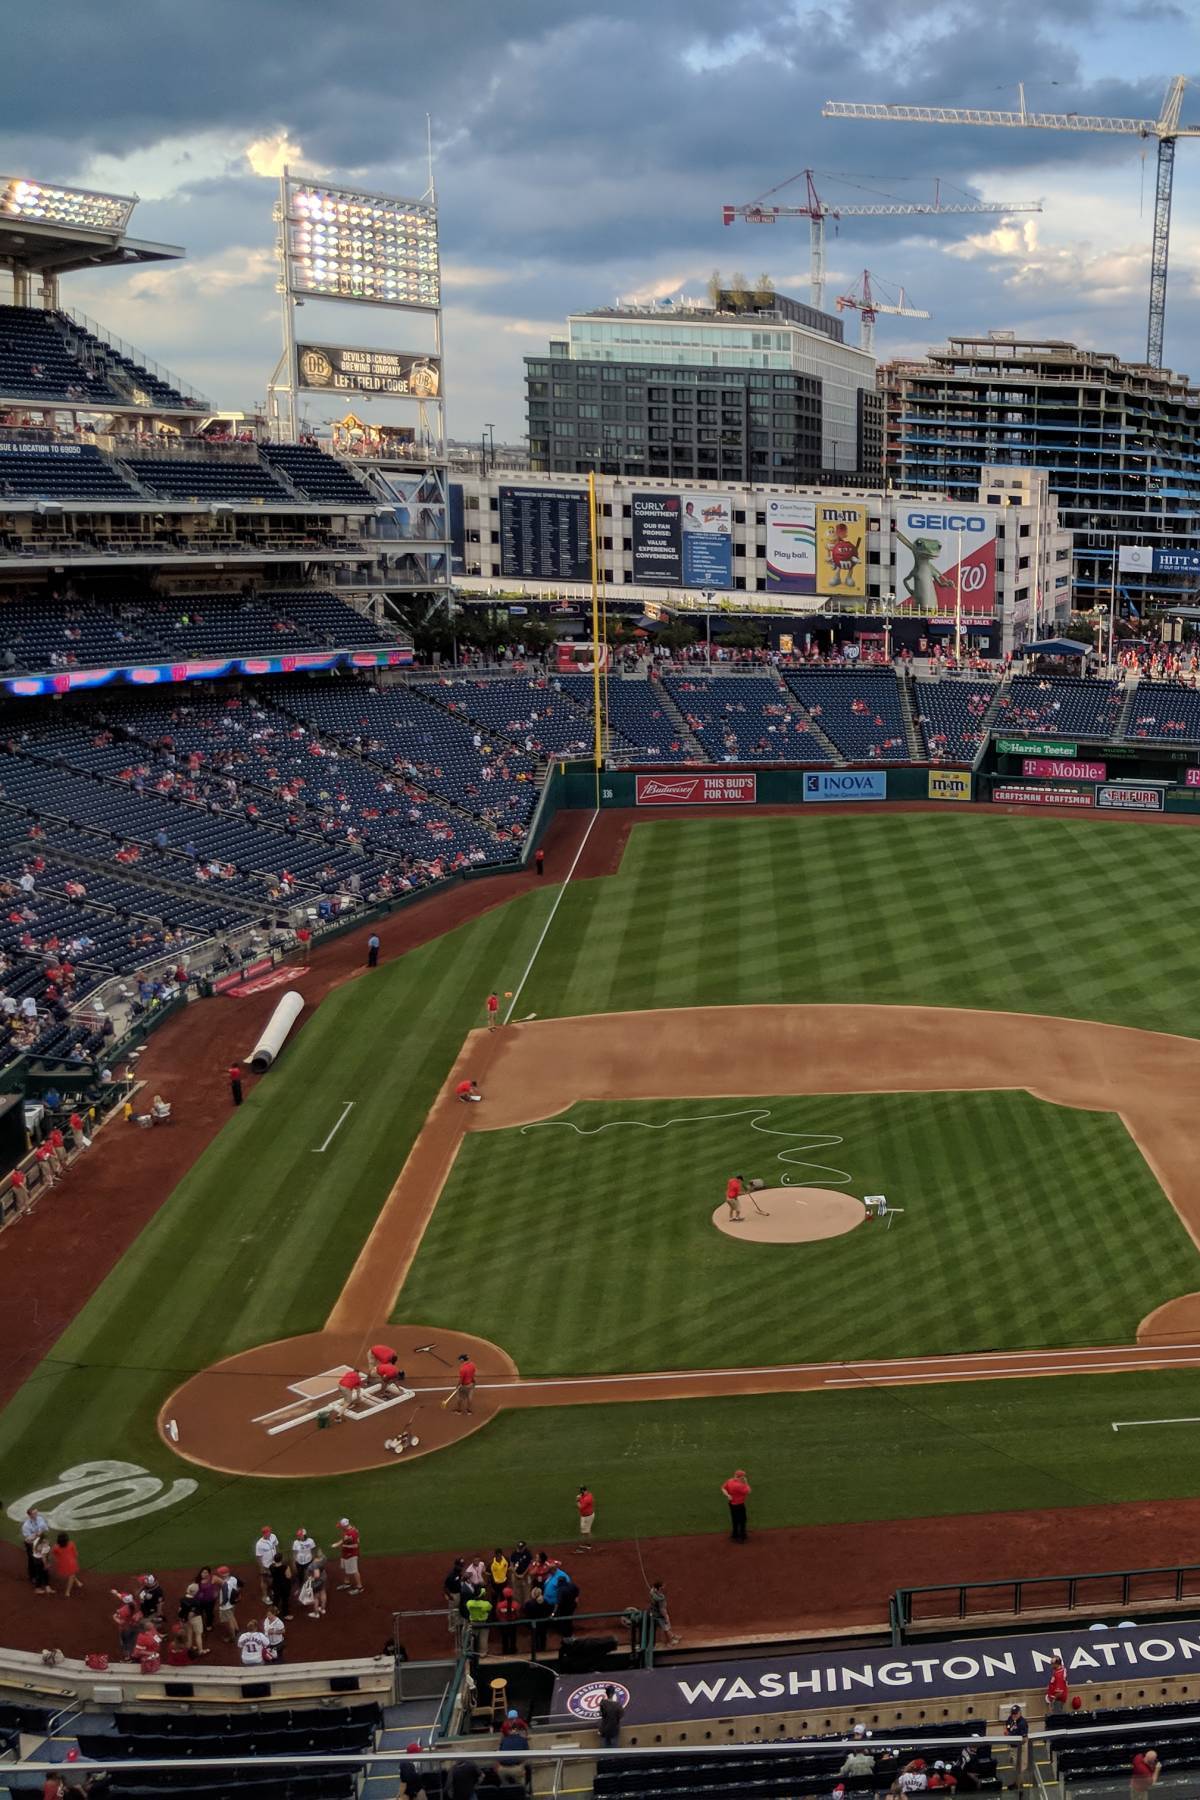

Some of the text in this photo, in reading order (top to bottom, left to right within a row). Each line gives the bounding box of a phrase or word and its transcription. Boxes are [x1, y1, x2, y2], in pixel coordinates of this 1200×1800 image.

[343, 351, 400, 366] DEVILS BACKBONE
[341, 362, 400, 375] BREWING COMPANY
[334, 374, 408, 392] LEFT FIELD LODGE
[20, 444, 49, 452] LOCATION
[60, 446, 81, 454] 69050
[634, 501, 665, 510] CURLY
[908, 513, 985, 532] GEICO
[774, 550, 808, 559] Play ball.
[1160, 555, 1190, 565] HITT
[1011, 744, 1074, 755] Harris Teeter
[704, 778, 753, 788] THIS BUD'S
[824, 776, 873, 789] INOVA
[645, 784, 693, 794] Budweiser
[704, 789, 744, 798] FOR YOU.
[995, 791, 1090, 804] CRAFTSMAN CRAFTSMAN
[678, 1652, 1016, 1704] WASHINGTON
